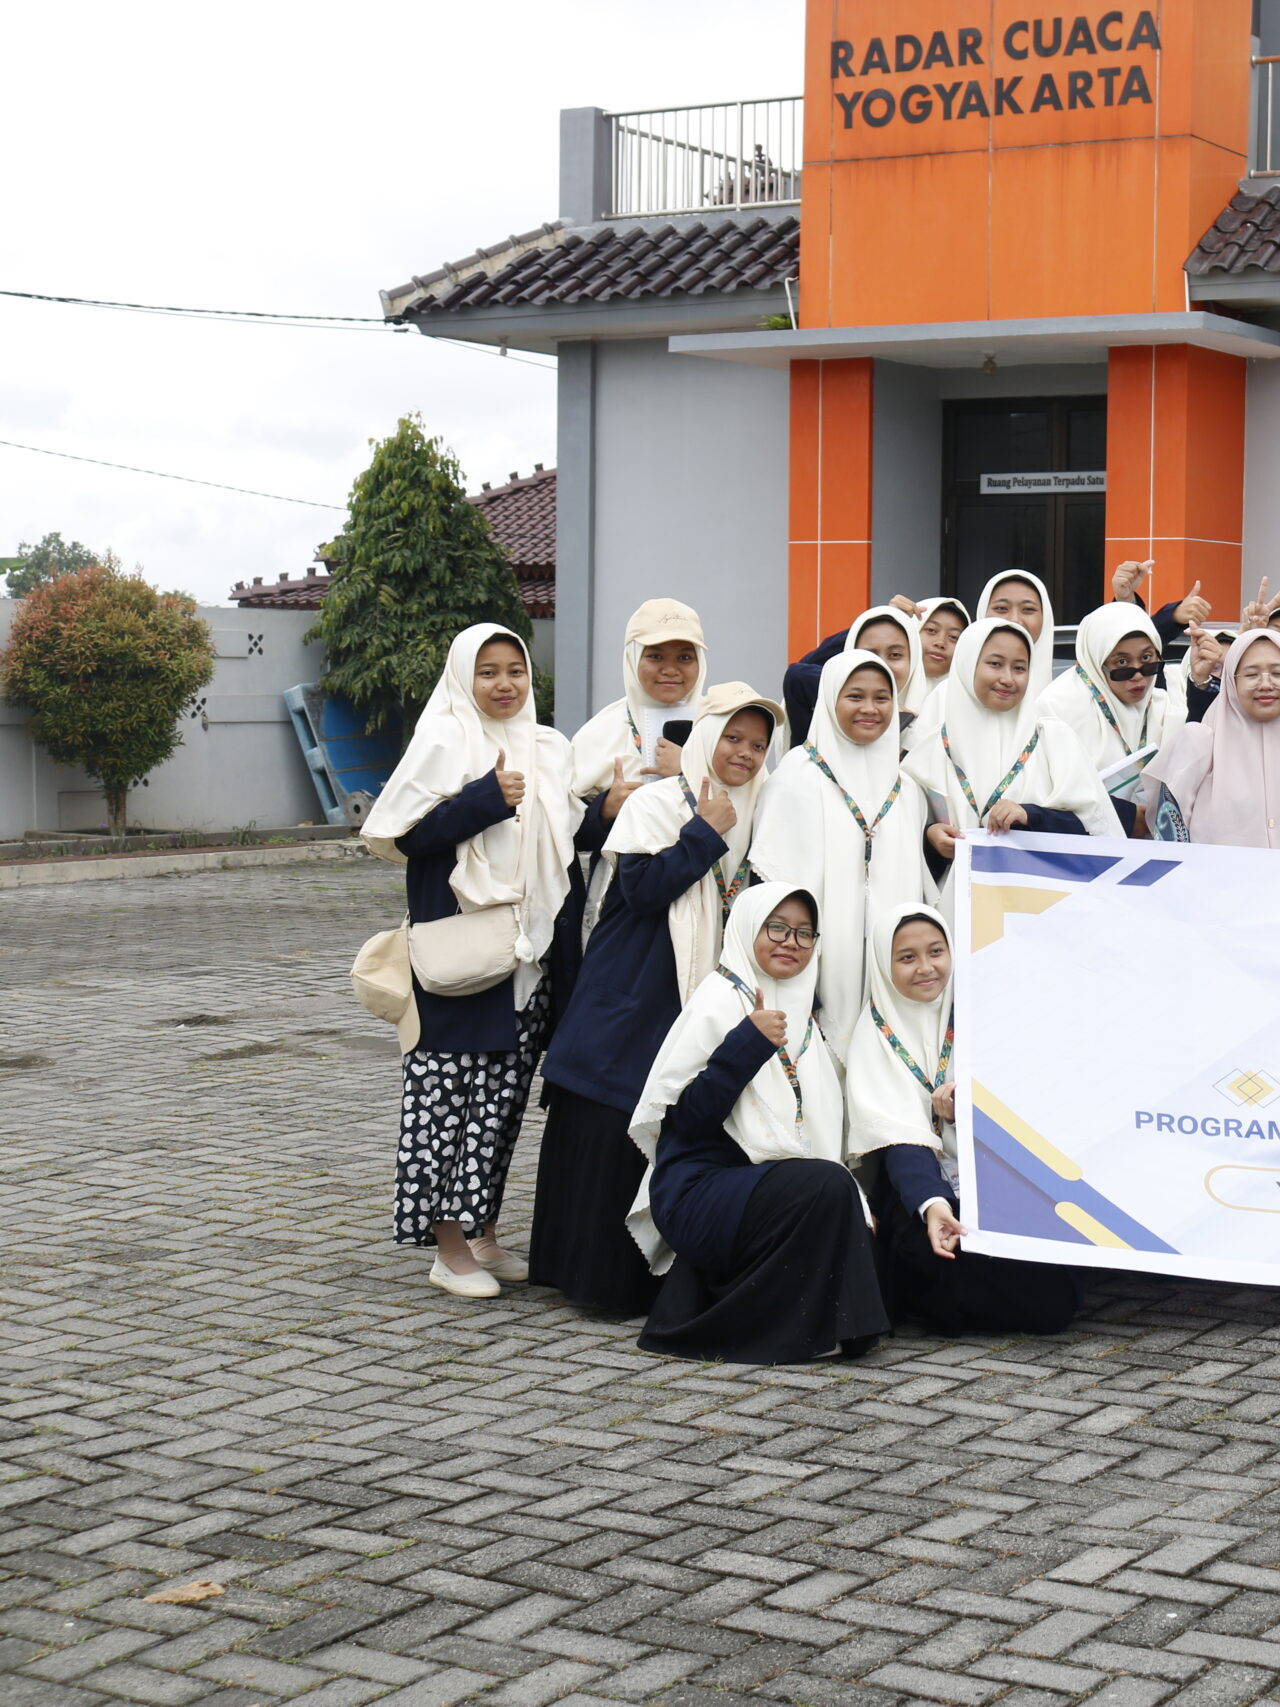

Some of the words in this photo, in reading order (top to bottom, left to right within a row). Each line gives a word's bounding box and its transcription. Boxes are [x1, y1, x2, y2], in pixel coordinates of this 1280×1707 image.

[830, 27, 984, 79] RADAR
[1003, 10, 1161, 60] CUACA
[834, 65, 1152, 129] YOGYAKARTA
[987, 477, 1011, 489] Ruang
[1012, 476, 1051, 488] Pelayanan
[1053, 475, 1085, 488] Terpadu
[1086, 475, 1104, 485] Satu
